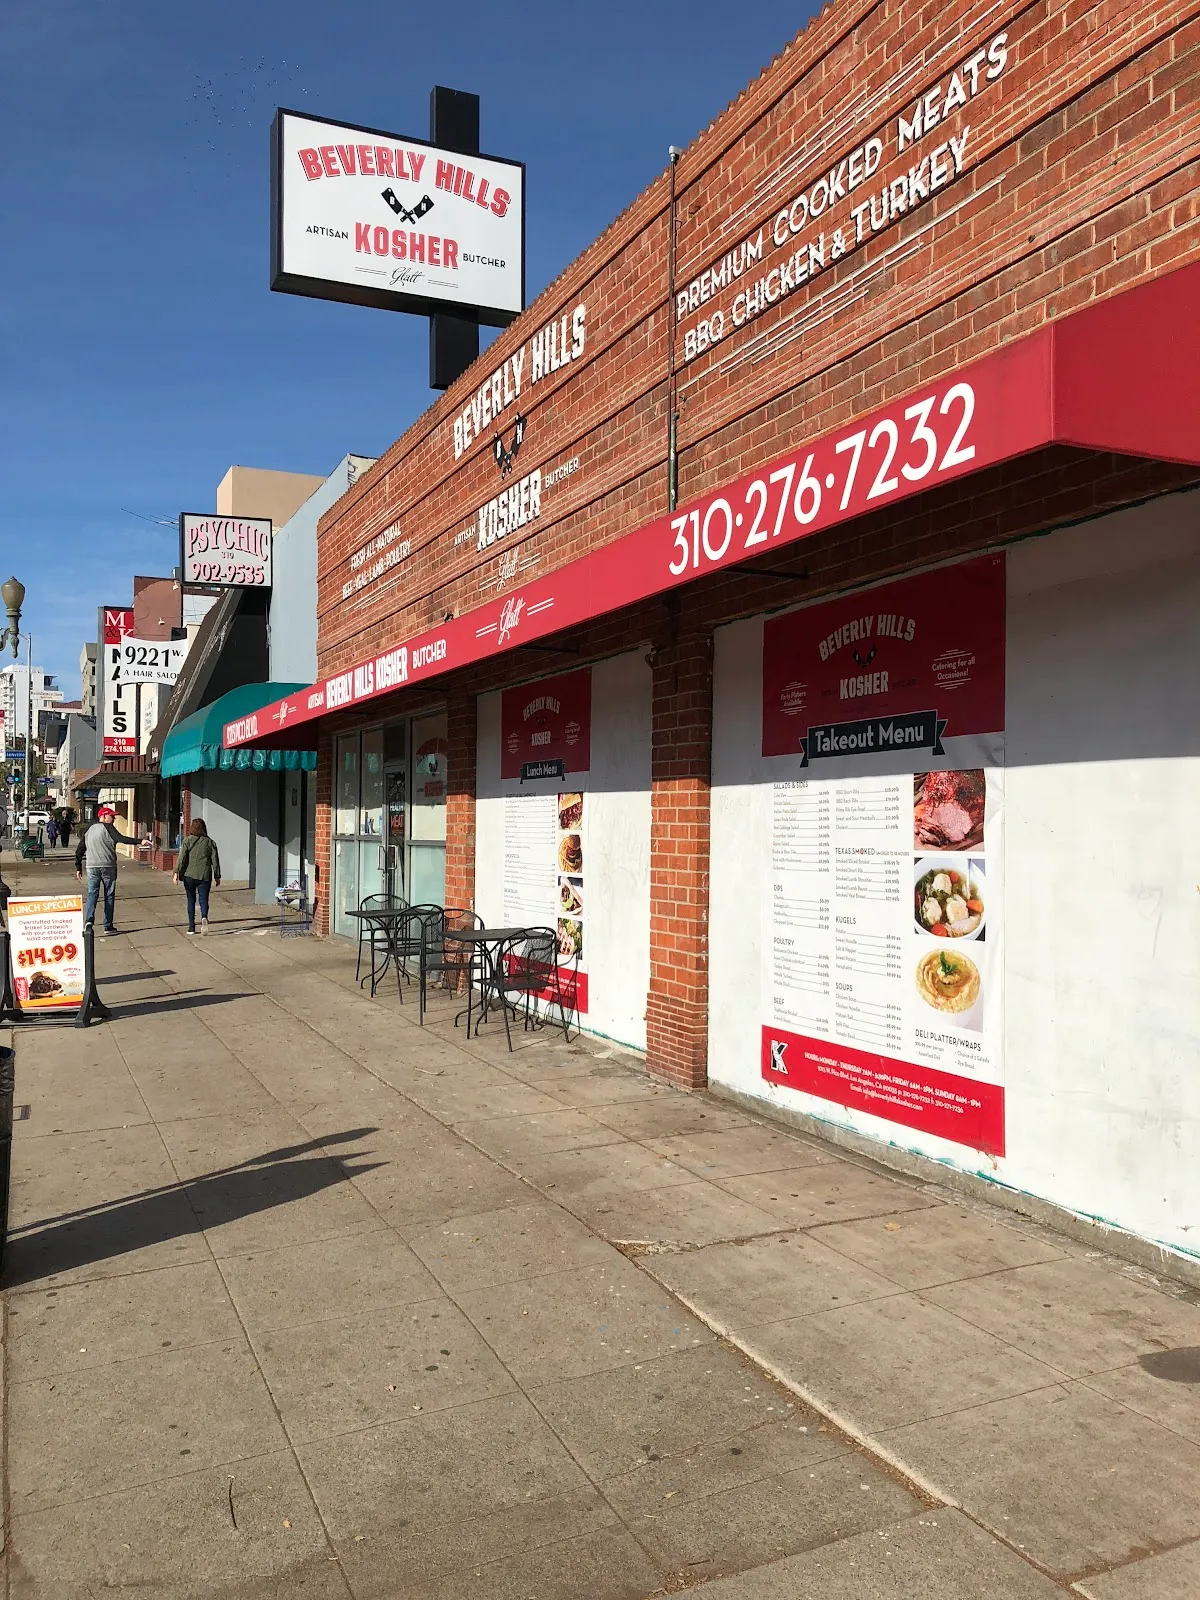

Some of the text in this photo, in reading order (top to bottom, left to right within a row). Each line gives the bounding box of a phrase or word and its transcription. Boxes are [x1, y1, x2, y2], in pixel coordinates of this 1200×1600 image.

[298, 145, 511, 218] BEVERLY HILLS
[677, 32, 1008, 321] PREMIUM COOKED MEATS
[306, 222, 506, 270] ARTISAN KOSHER BUTCHER
[684, 125, 971, 362] BBQ CHICKEN & TURKEY
[390, 267, 426, 286] Glatt
[453, 303, 586, 461] BEVERLY HILLS
[454, 457, 579, 551] ARTISAN KOSHER BUTCHER
[188, 520, 269, 561] PSYCHIC
[192, 561, 265, 584] 902-9535
[105, 611, 127, 627] M
[498, 597, 526, 645] Glatt
[818, 614, 917, 662] BEVERLY HILLS
[125, 646, 169, 667] 9221
[932, 656, 976, 673] Catering for all
[134, 669, 153, 678] HAIR
[326, 670, 353, 710] BEVERLY
[354, 662, 374, 699] HILLS
[376, 646, 408, 690] KOSHER
[412, 639, 447, 669] BUTCHER
[839, 670, 889, 700] KOSHER
[936, 668, 969, 681] Occasions!
[522, 696, 561, 722] BEVERLY HILLS
[531, 730, 552, 747] KOSHER
[815, 721, 924, 753] Takeout Menu
[526, 762, 558, 777] Lunch Menu
[852, 848, 876, 856] SMOKED
[12, 899, 78, 914] LUNCH SPECIAL
[836, 916, 857, 925] KUGELS
[774, 937, 795, 947] POULTRY
[18, 943, 78, 967] $14.99
[836, 982, 853, 992] SOUPS
[774, 997, 785, 1005] BEEF
[915, 1029, 929, 1039] DELI
[930, 1032, 982, 1052] PLATTER/WRAPS
[771, 1040, 788, 1075] K
[819, 1056, 838, 1067] MONDAY
[840, 1062, 863, 1074] THURSDAY
[892, 1076, 910, 1087] FRIDAY
[935, 1088, 956, 1101] SUNDAY
[850, 1073, 858, 1082] Los
[875, 1081, 883, 1090] CA
